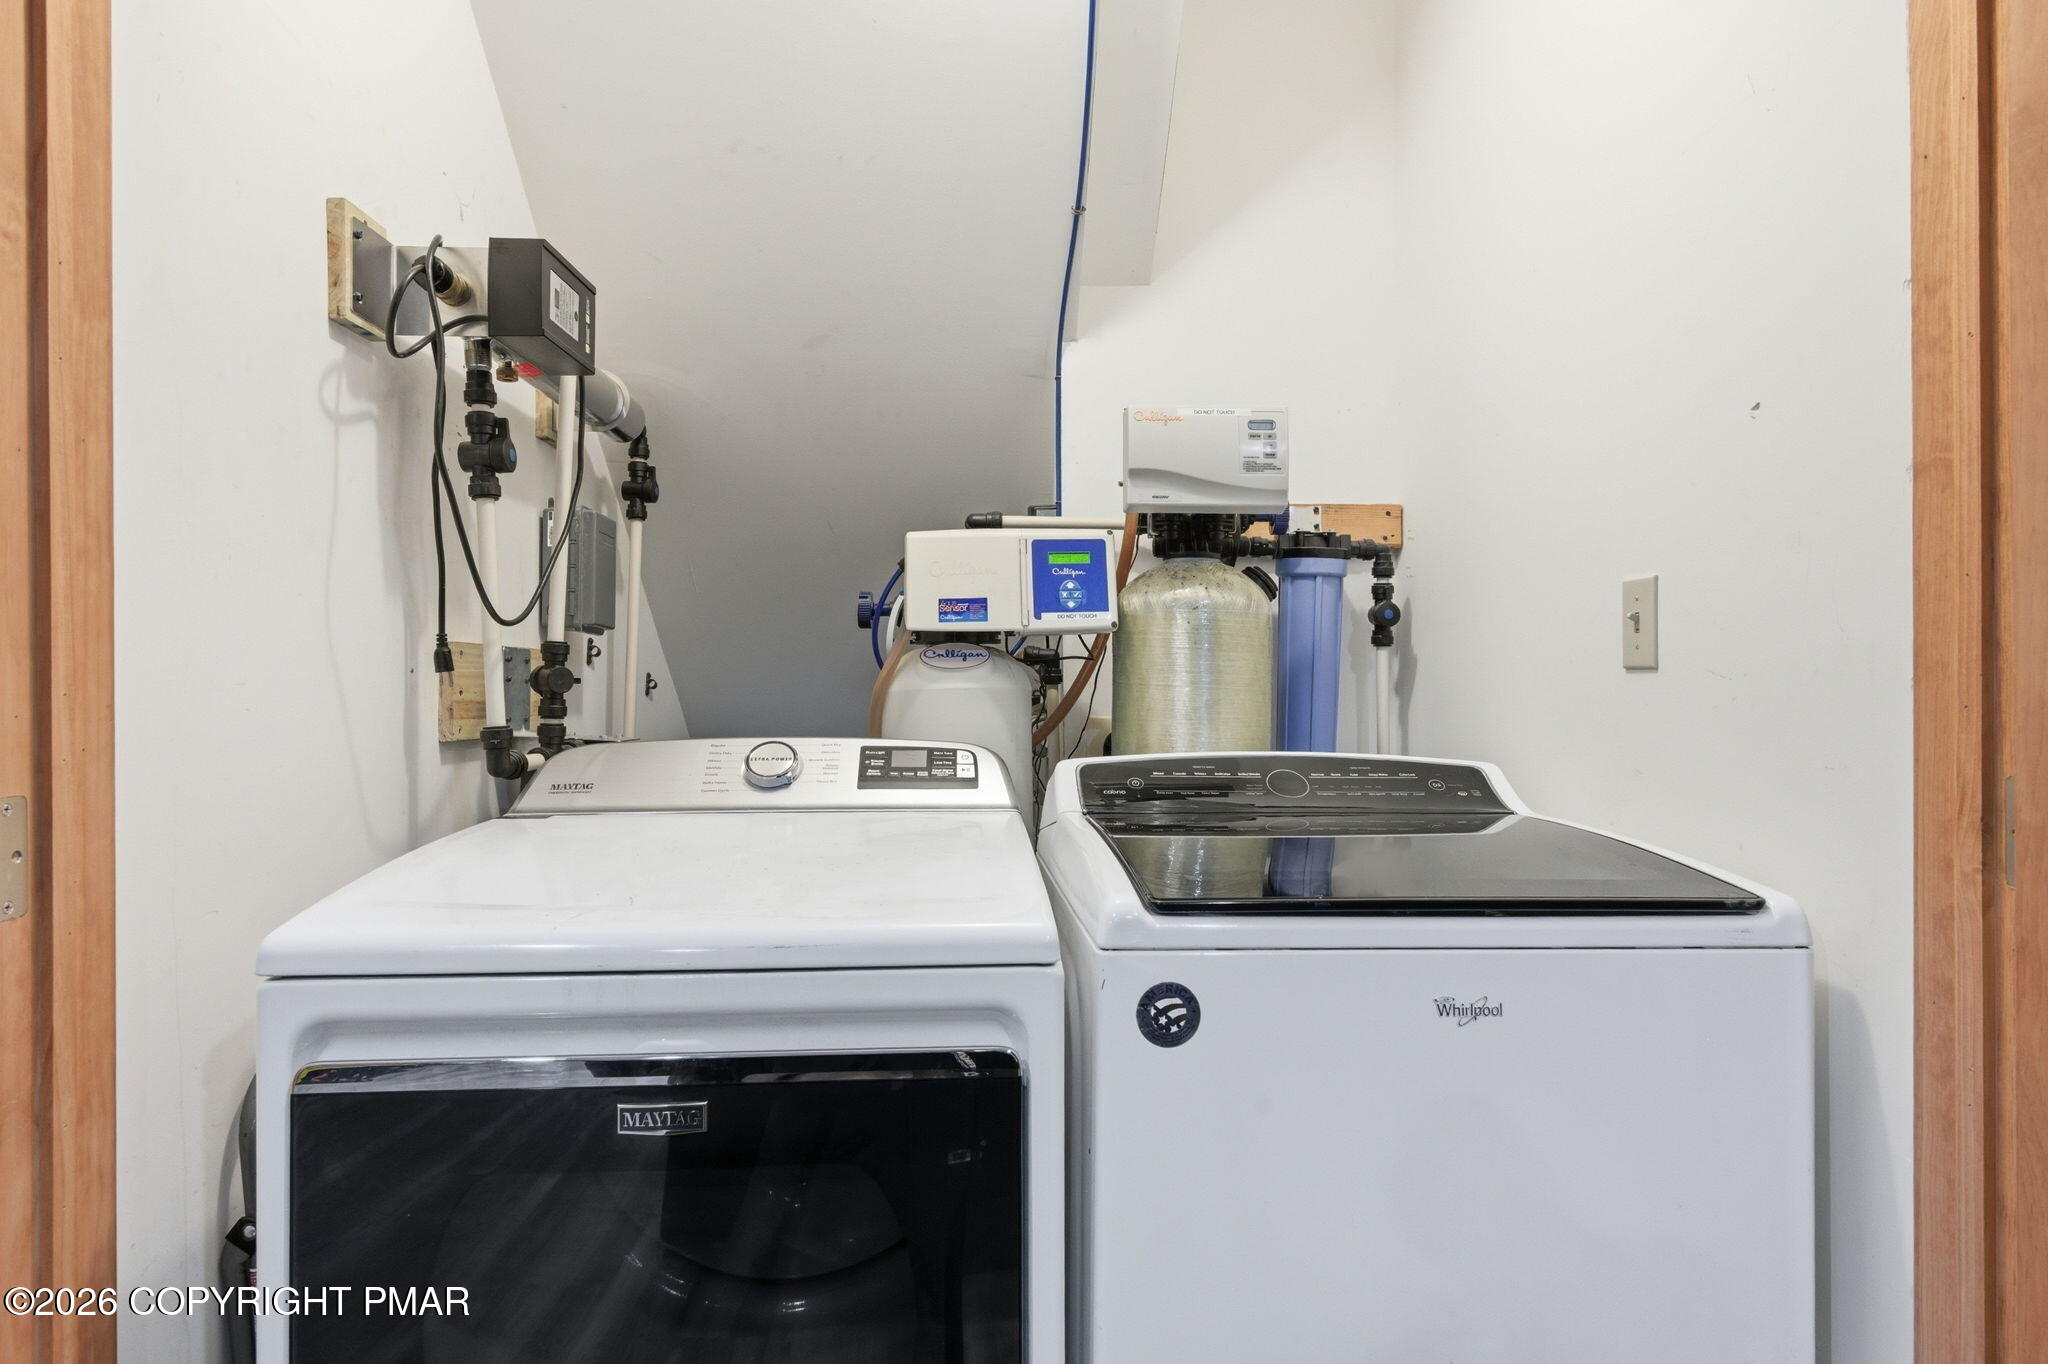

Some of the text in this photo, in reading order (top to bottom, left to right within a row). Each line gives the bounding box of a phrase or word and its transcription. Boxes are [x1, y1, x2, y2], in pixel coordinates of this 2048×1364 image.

[1133, 410, 1184, 426] Culligan
[1052, 567, 1087, 578] Culligan
[923, 649, 987, 662] Culligan
[1436, 1002, 1503, 1020] Whirlpool
[622, 1110, 702, 1127] MAYTAG
